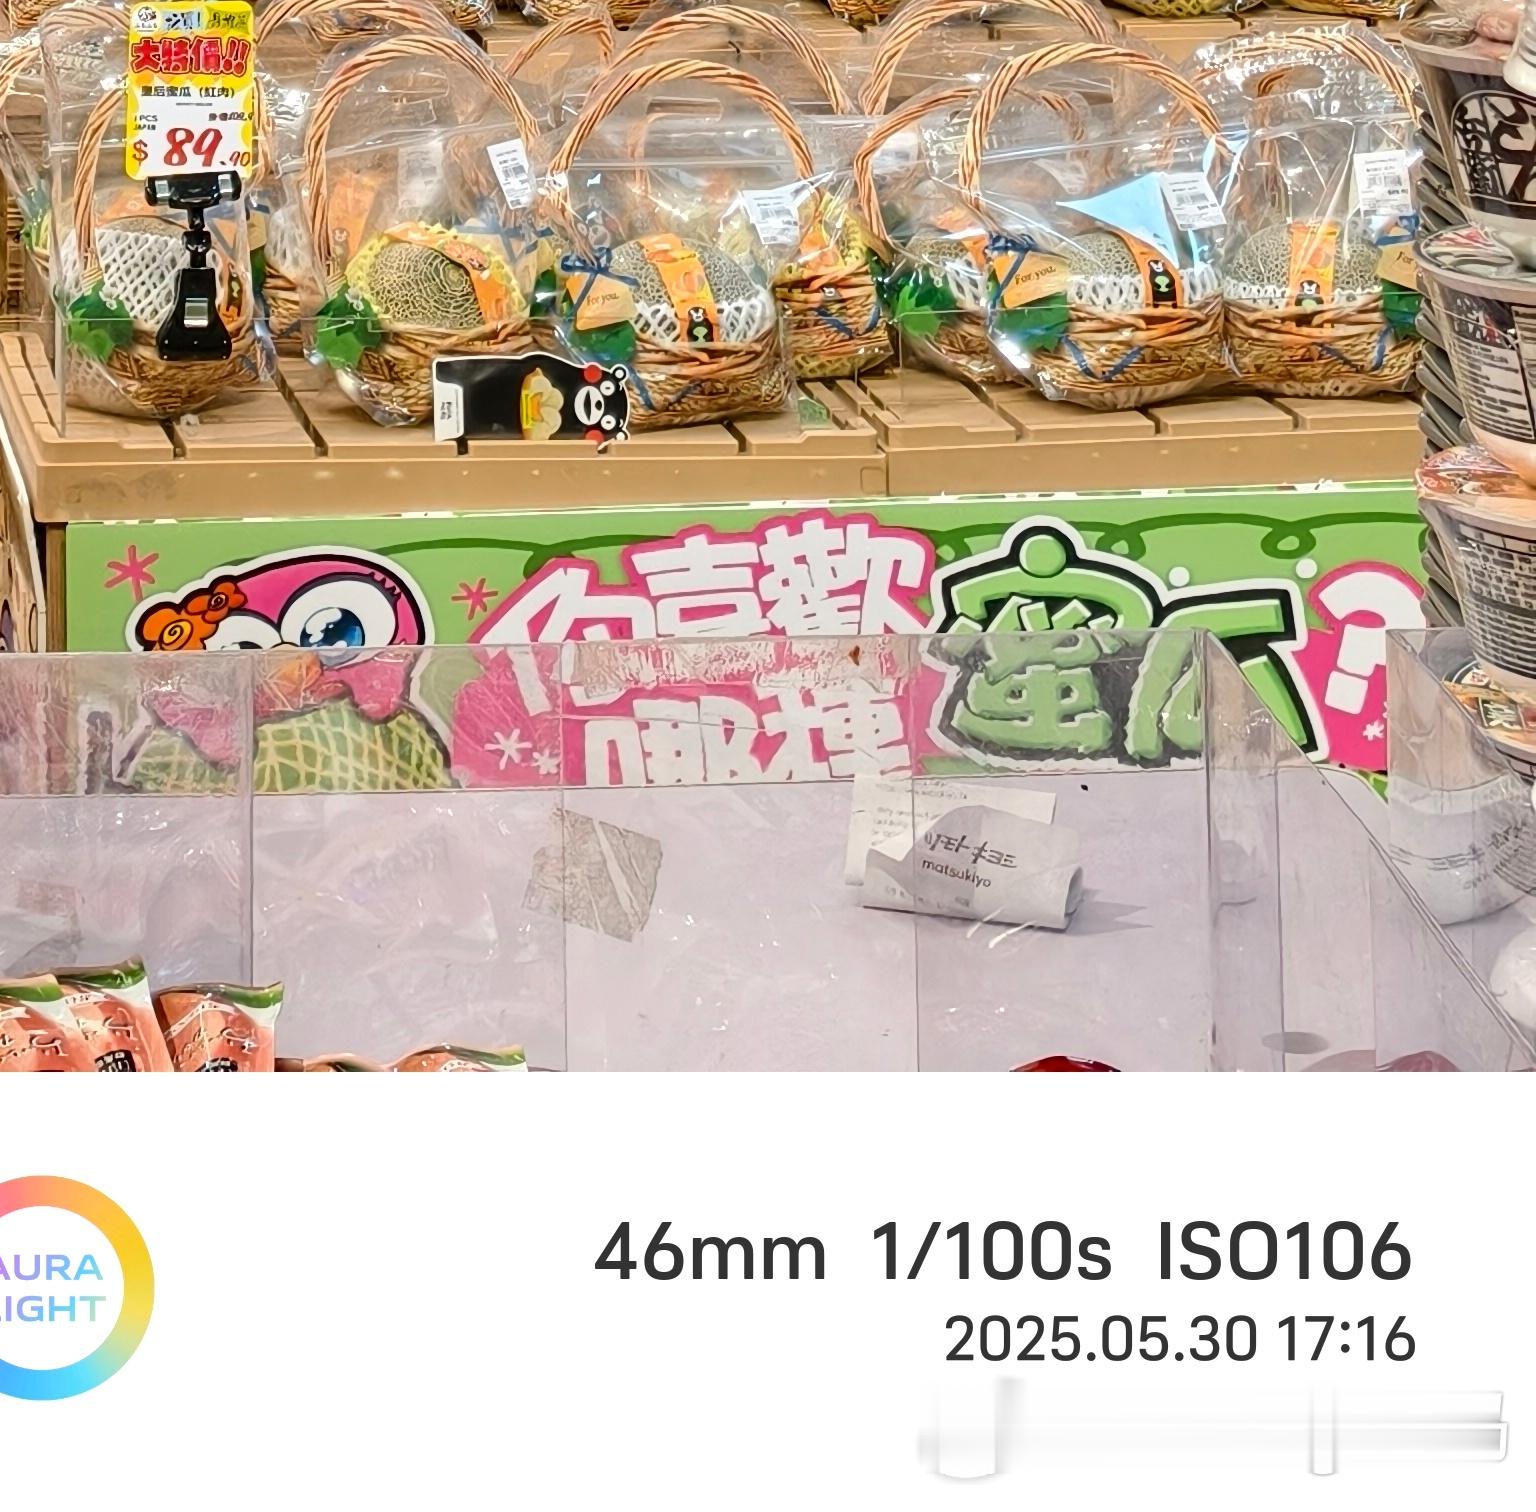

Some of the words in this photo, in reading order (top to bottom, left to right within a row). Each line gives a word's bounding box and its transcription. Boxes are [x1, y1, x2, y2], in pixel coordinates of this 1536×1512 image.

[131, 36, 251, 77] 大特價!!
[139, 114, 158, 123] PCS
[921, 857, 993, 889] matsukiyo
